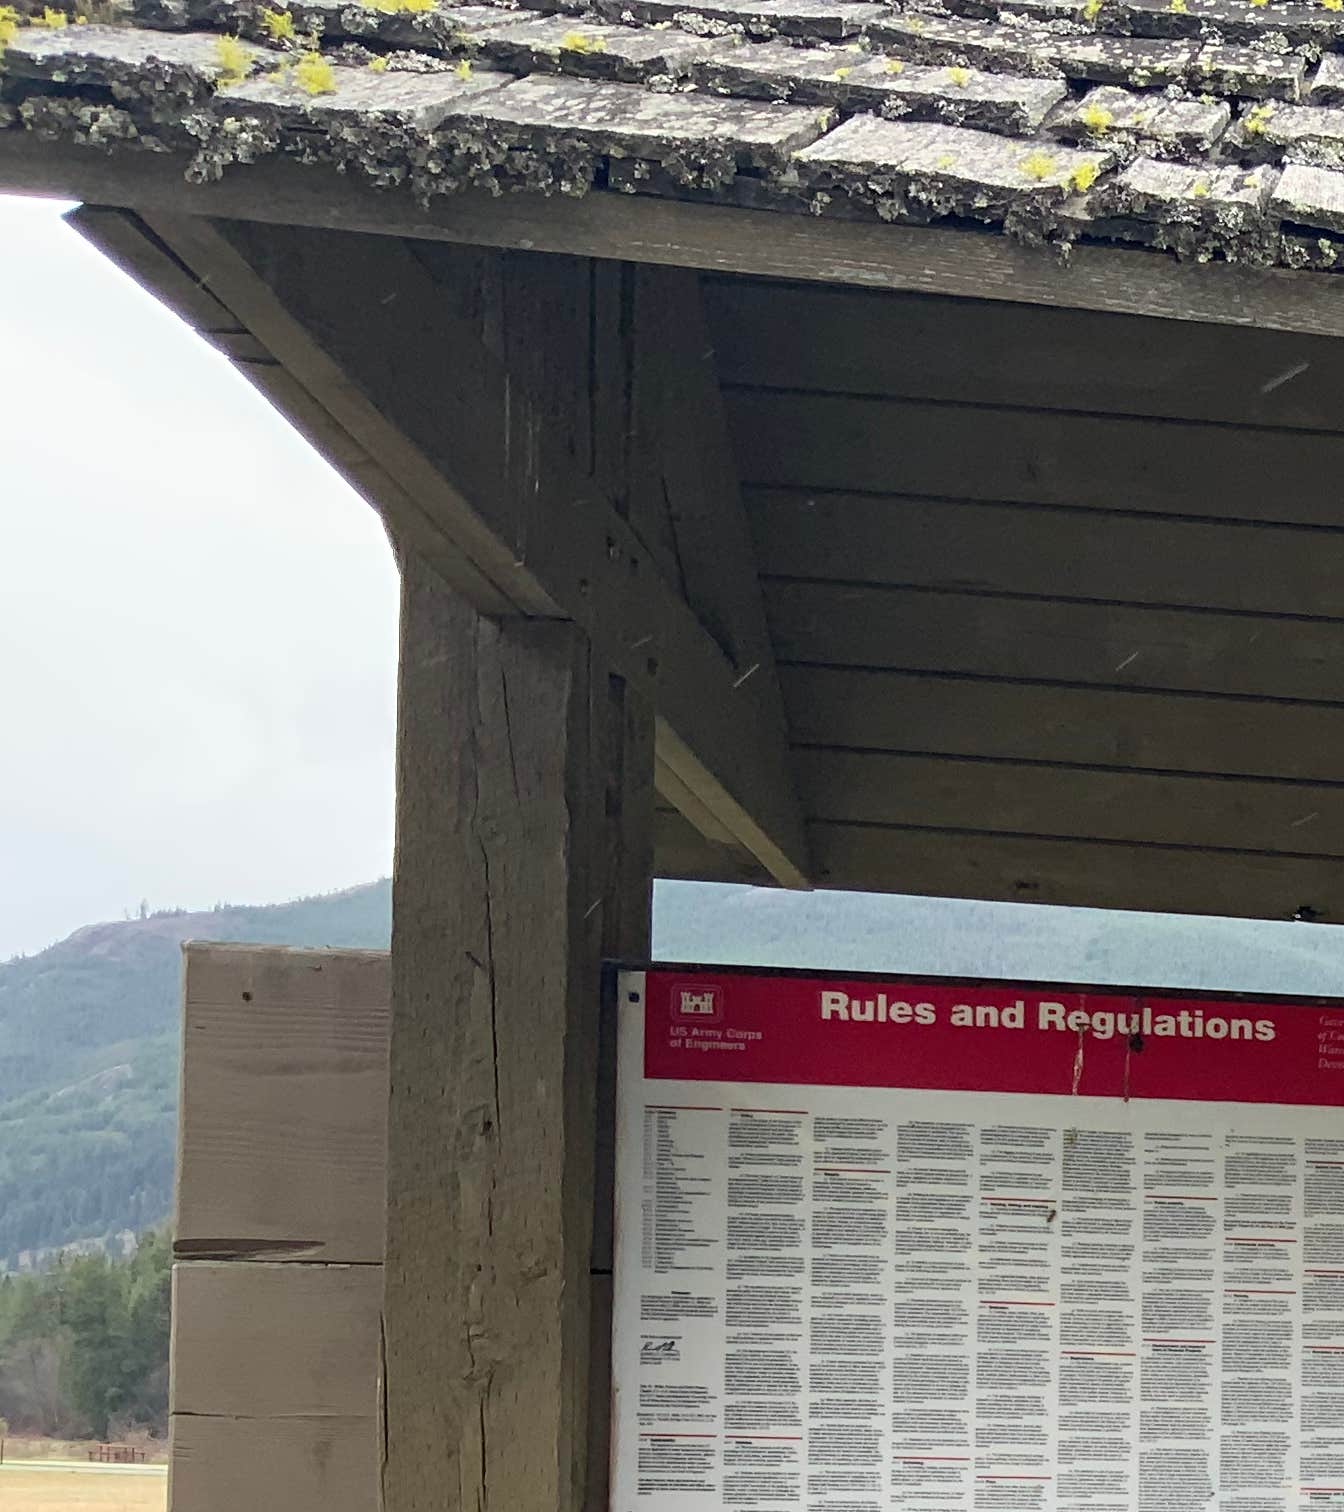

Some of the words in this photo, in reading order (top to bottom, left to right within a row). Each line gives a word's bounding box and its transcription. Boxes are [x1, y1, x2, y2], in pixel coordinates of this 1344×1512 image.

[821, 991, 936, 1024] Rules
[950, 1001, 1025, 1029] and
[1038, 1002, 1276, 1041] Regulations
